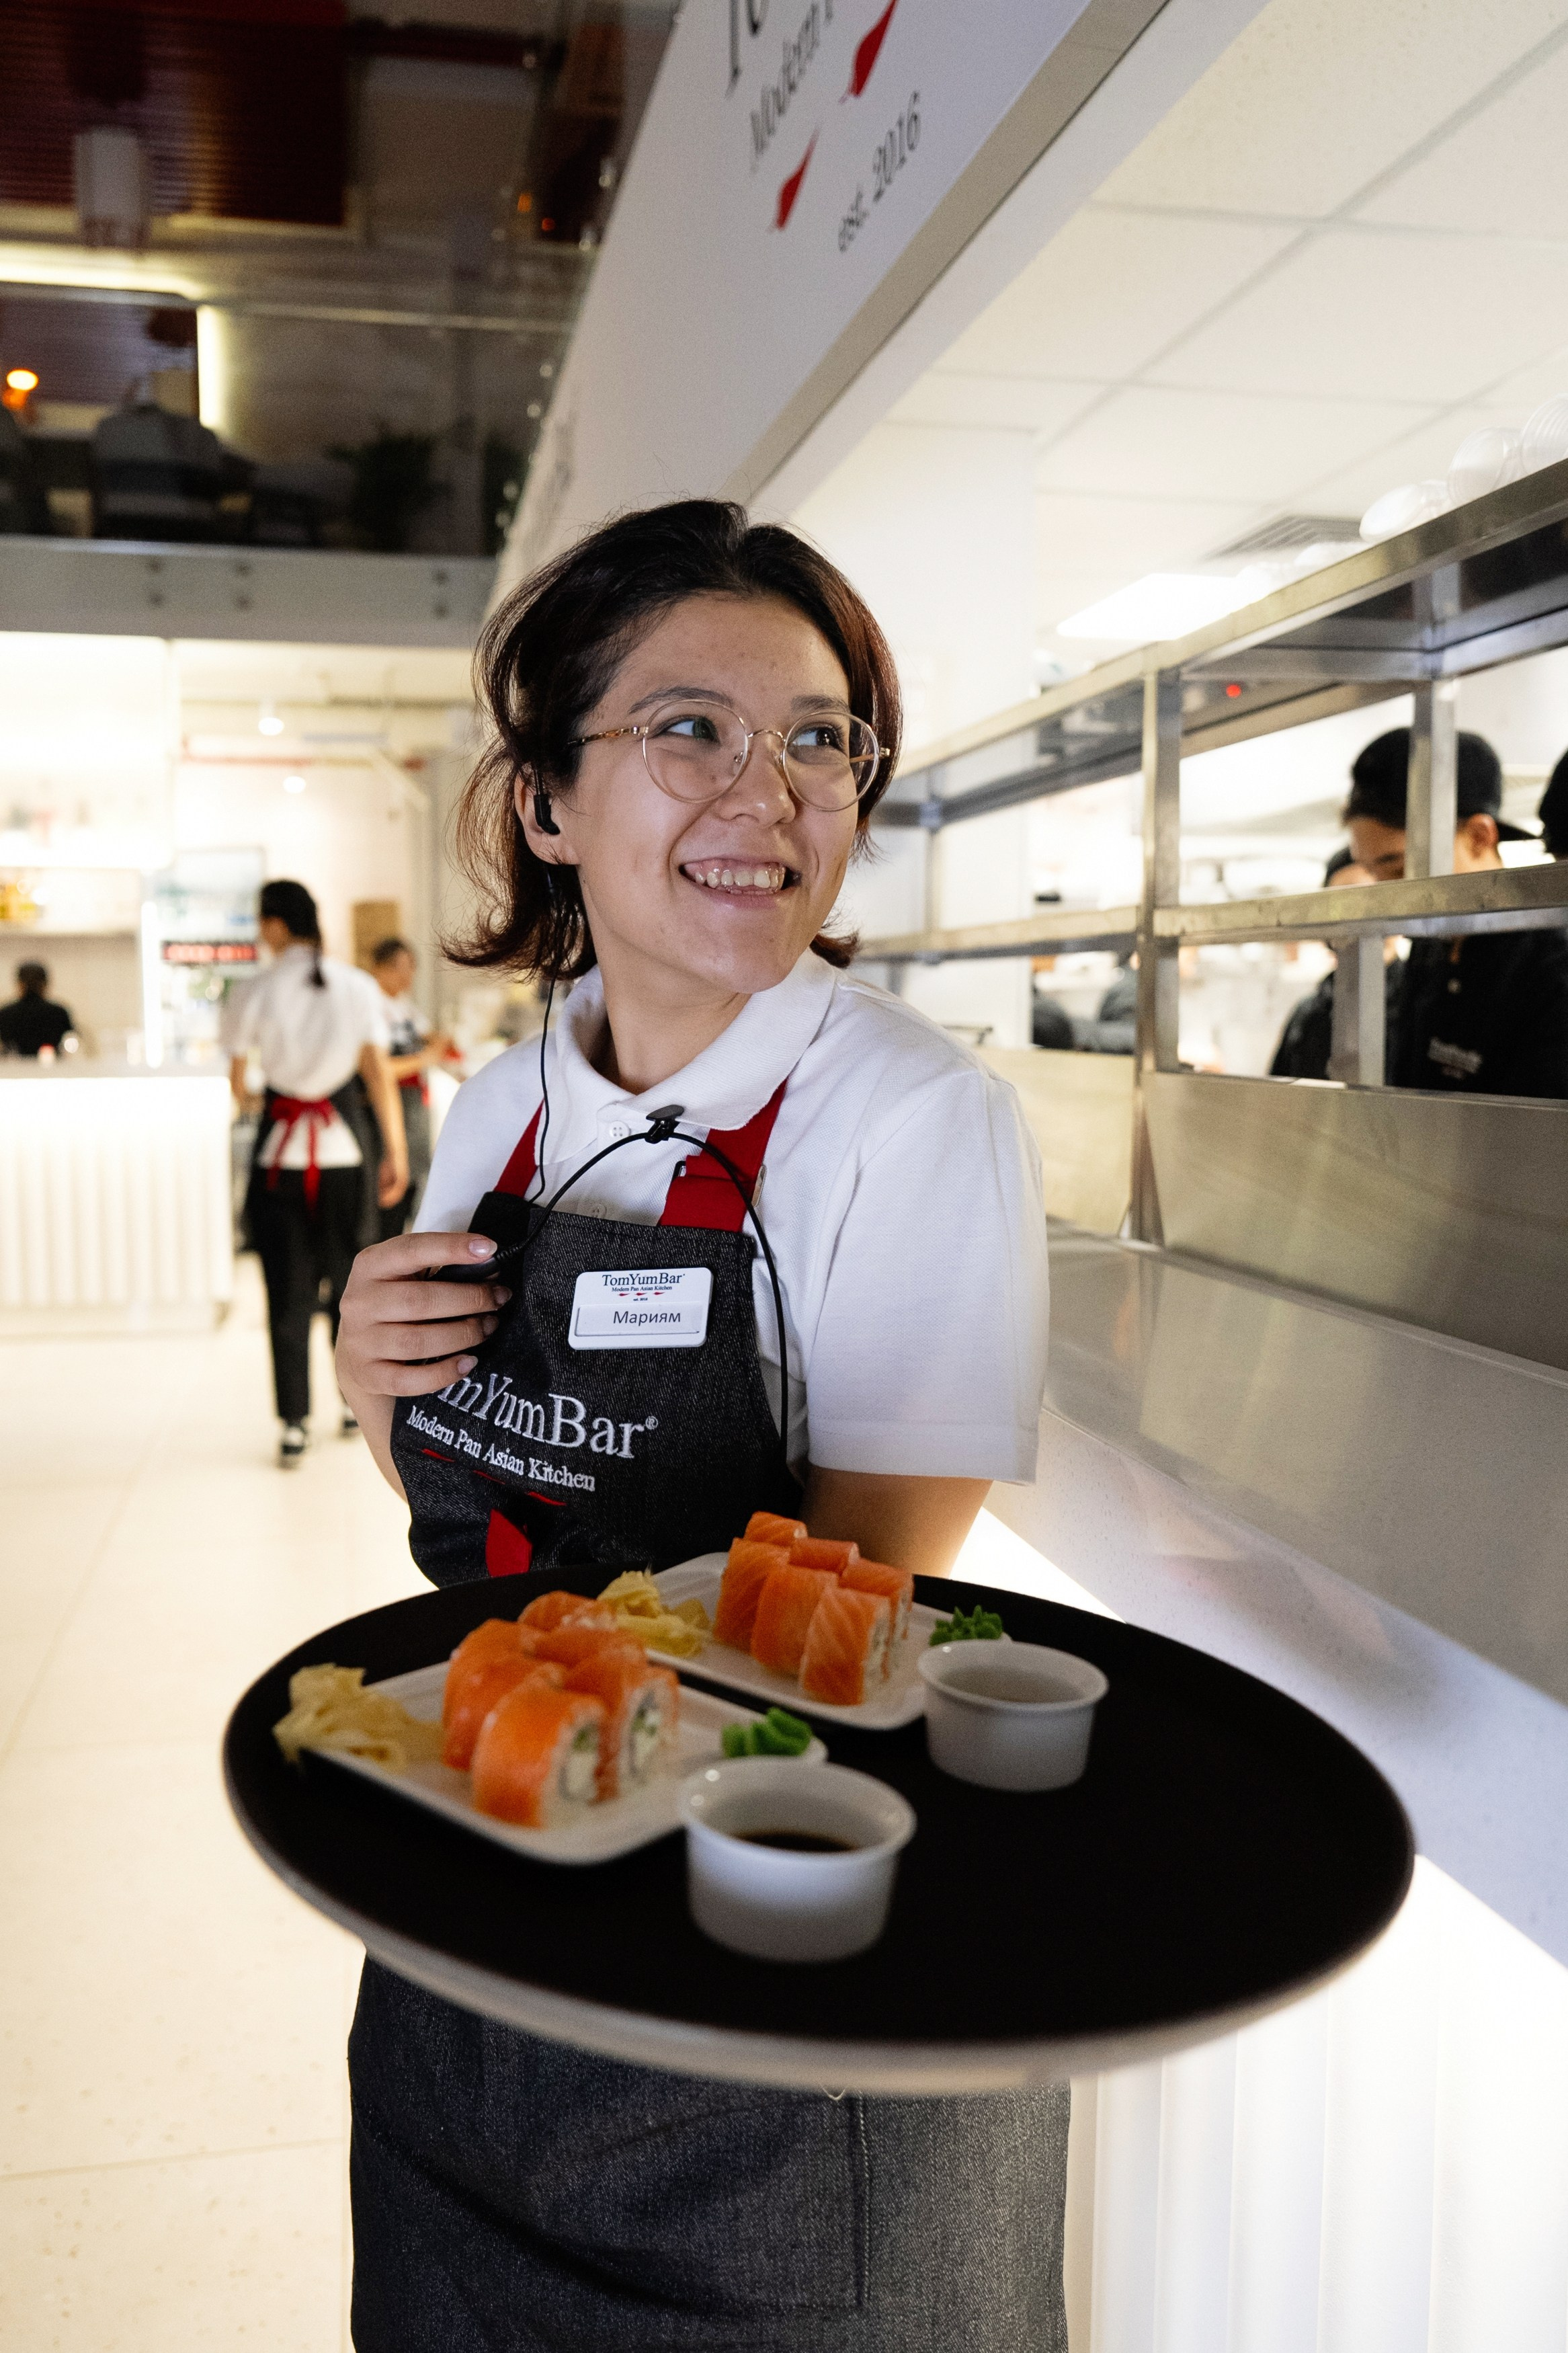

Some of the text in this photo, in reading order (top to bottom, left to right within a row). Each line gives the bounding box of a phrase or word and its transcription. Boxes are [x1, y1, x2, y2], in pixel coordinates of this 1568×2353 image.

[873, 89, 921, 203] 2016
[613, 1311, 681, 1326] Мариям
[406, 1405, 596, 1492] Modern Pan Asian Kitchen
